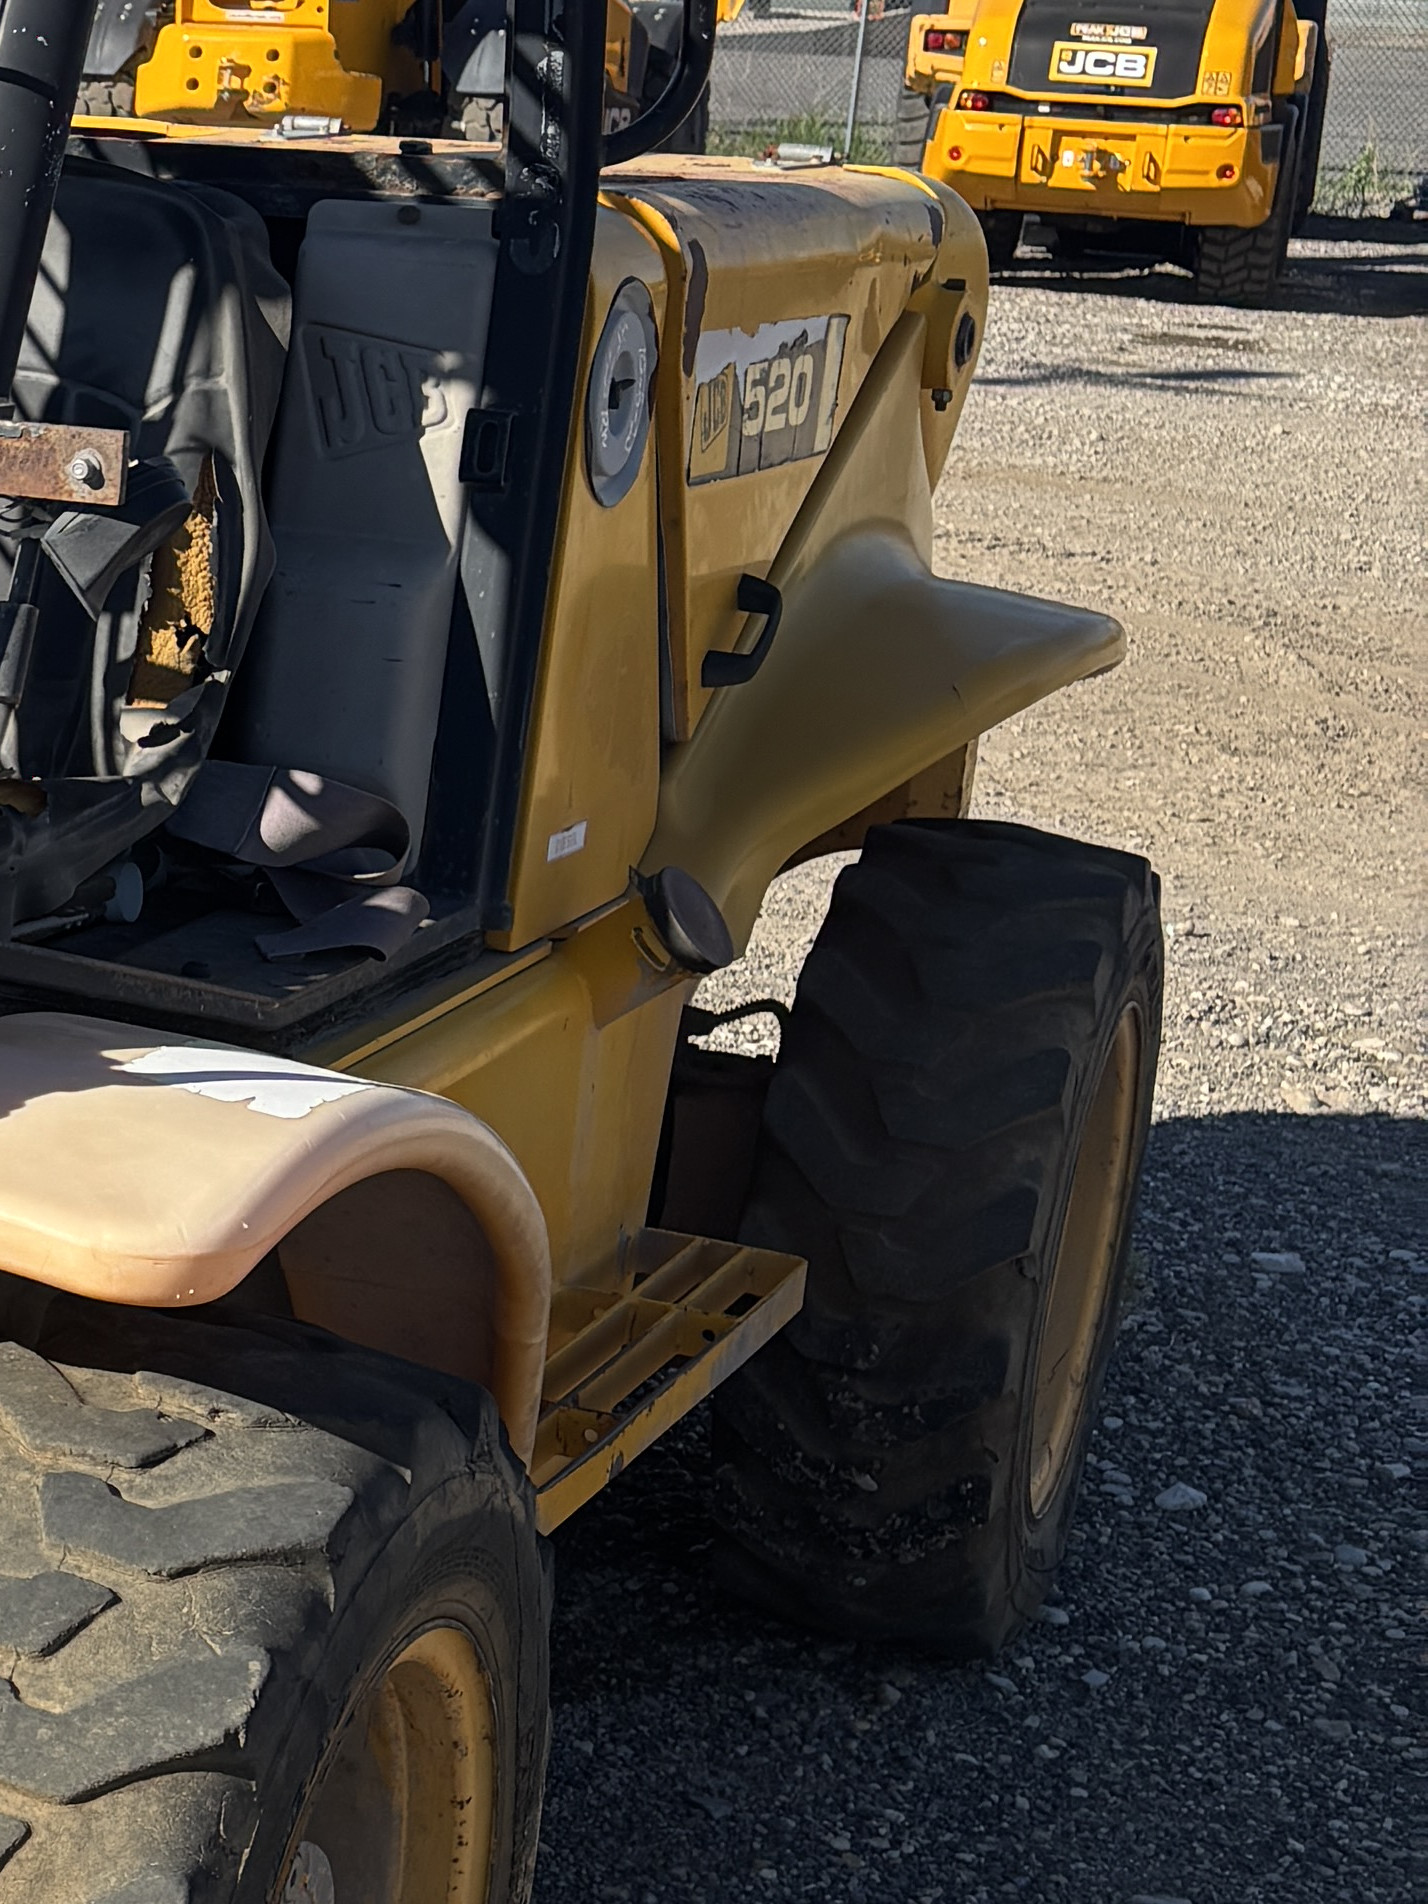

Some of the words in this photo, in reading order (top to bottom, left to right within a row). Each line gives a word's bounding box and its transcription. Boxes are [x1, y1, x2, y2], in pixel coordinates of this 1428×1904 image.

[1058, 49, 1147, 78] JCB
[316, 337, 448, 448] JCB
[742, 353, 814, 437] 520
